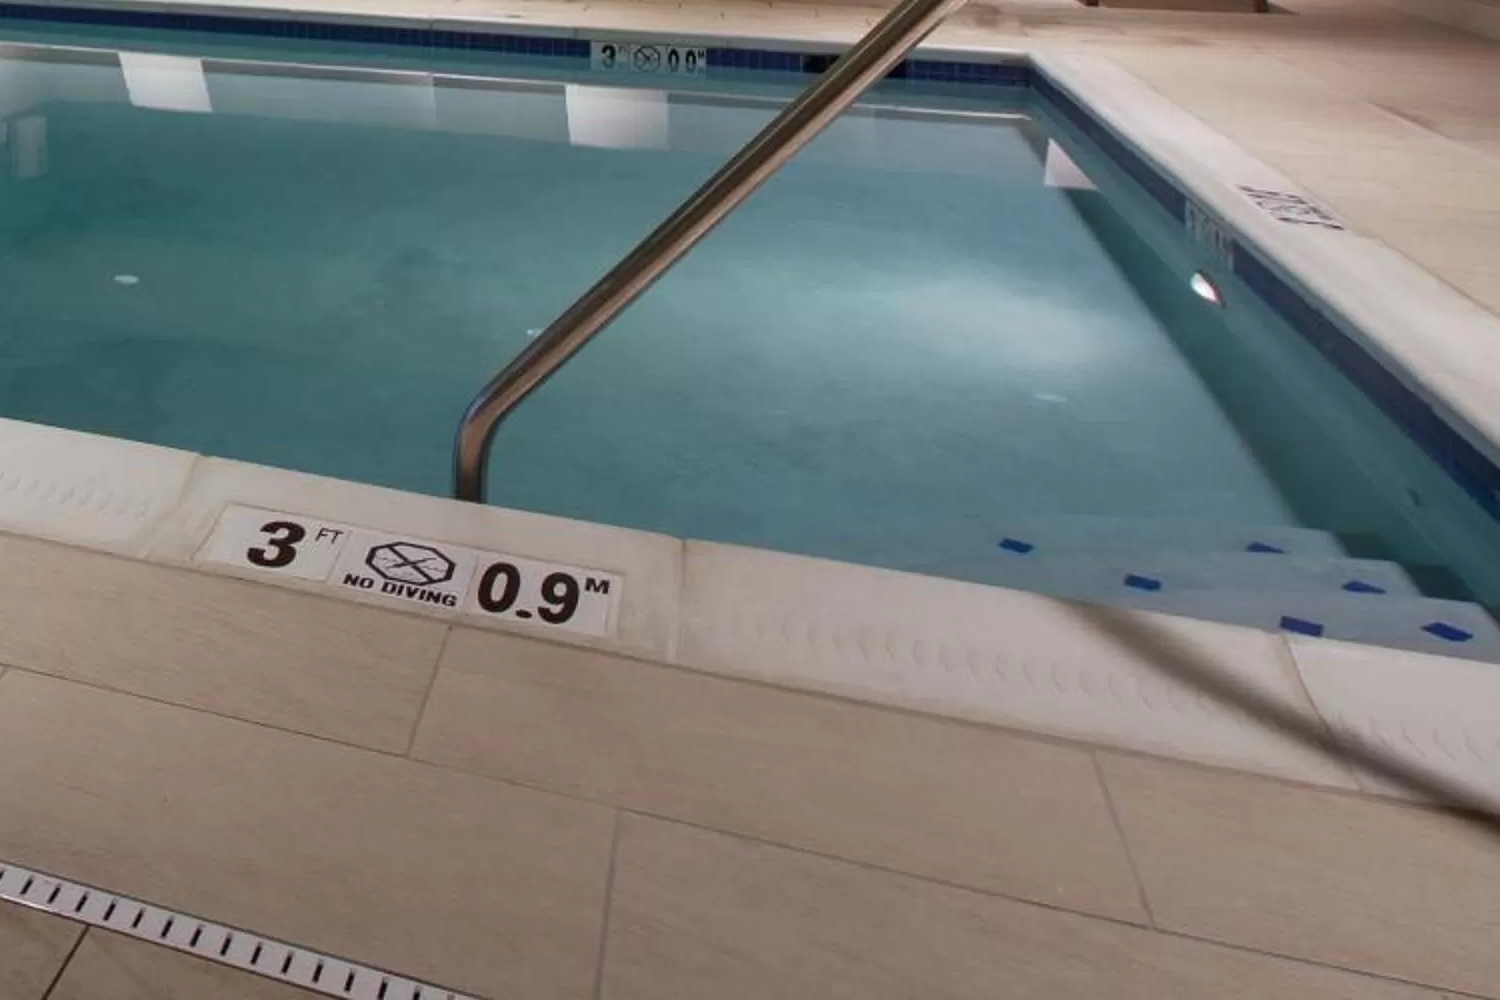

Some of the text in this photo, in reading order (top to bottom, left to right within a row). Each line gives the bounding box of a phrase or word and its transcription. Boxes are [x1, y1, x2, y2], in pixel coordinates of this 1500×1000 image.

[247, 521, 344, 568] 3 FT
[343, 573, 457, 607] NO DIVING
[477, 562, 611, 625] 0.9 M
